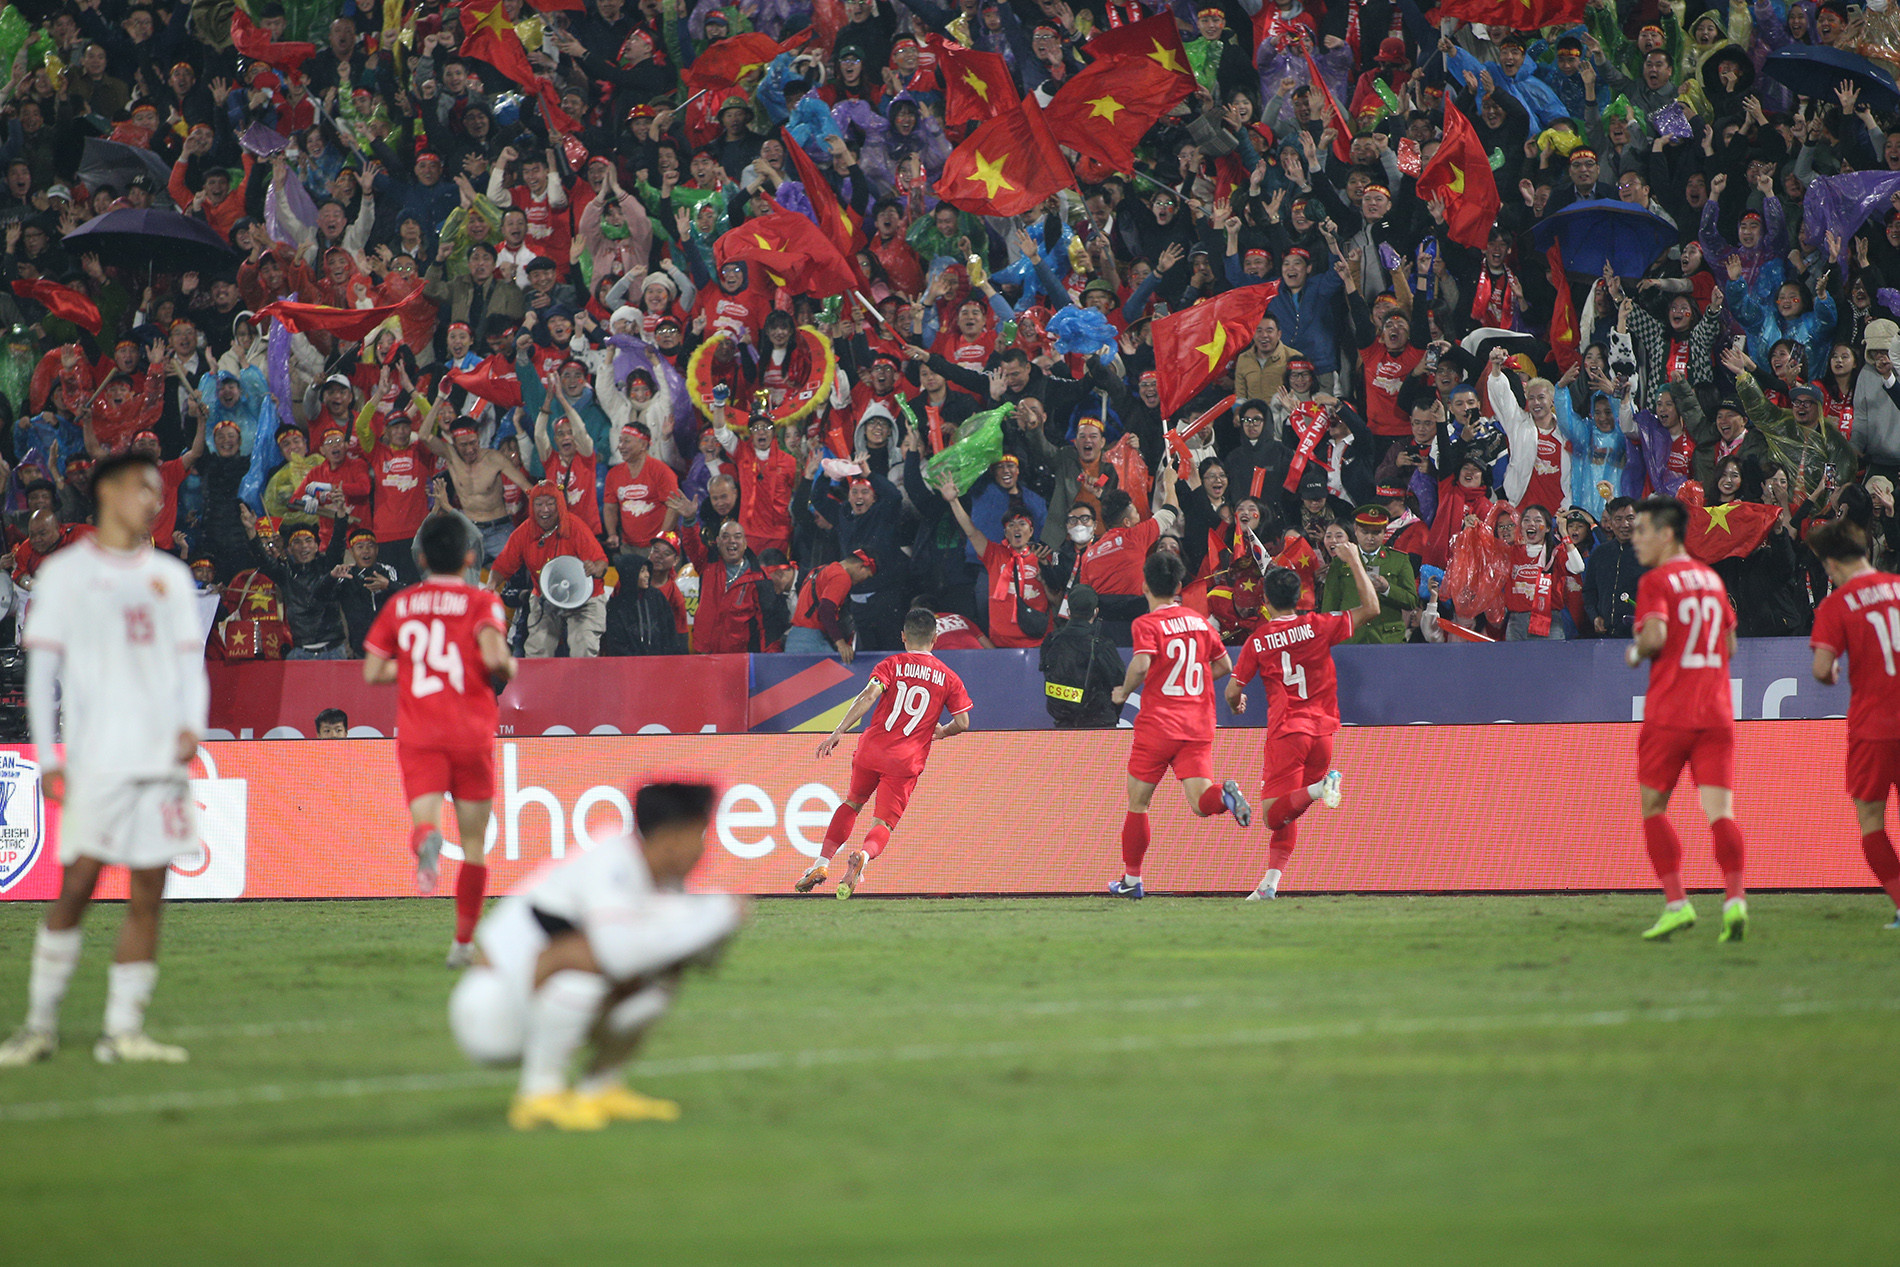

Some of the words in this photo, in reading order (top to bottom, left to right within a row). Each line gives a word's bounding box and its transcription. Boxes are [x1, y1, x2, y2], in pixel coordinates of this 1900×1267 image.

[1168, 616, 1187, 634] VAN
[1253, 638, 1266, 652] B.
[1264, 631, 1289, 649] TIEN
[1287, 624, 1315, 644] DUNG
[1678, 596, 1722, 668] 22
[398, 619, 465, 698] 24
[896, 664, 903, 677] N.
[904, 663, 932, 681] QUANG
[931, 669, 946, 687] HAI
[1161, 638, 1204, 696] 26
[1281, 651, 1308, 699] 4
[884, 680, 930, 737] 19
[440, 743, 846, 861] hoee
